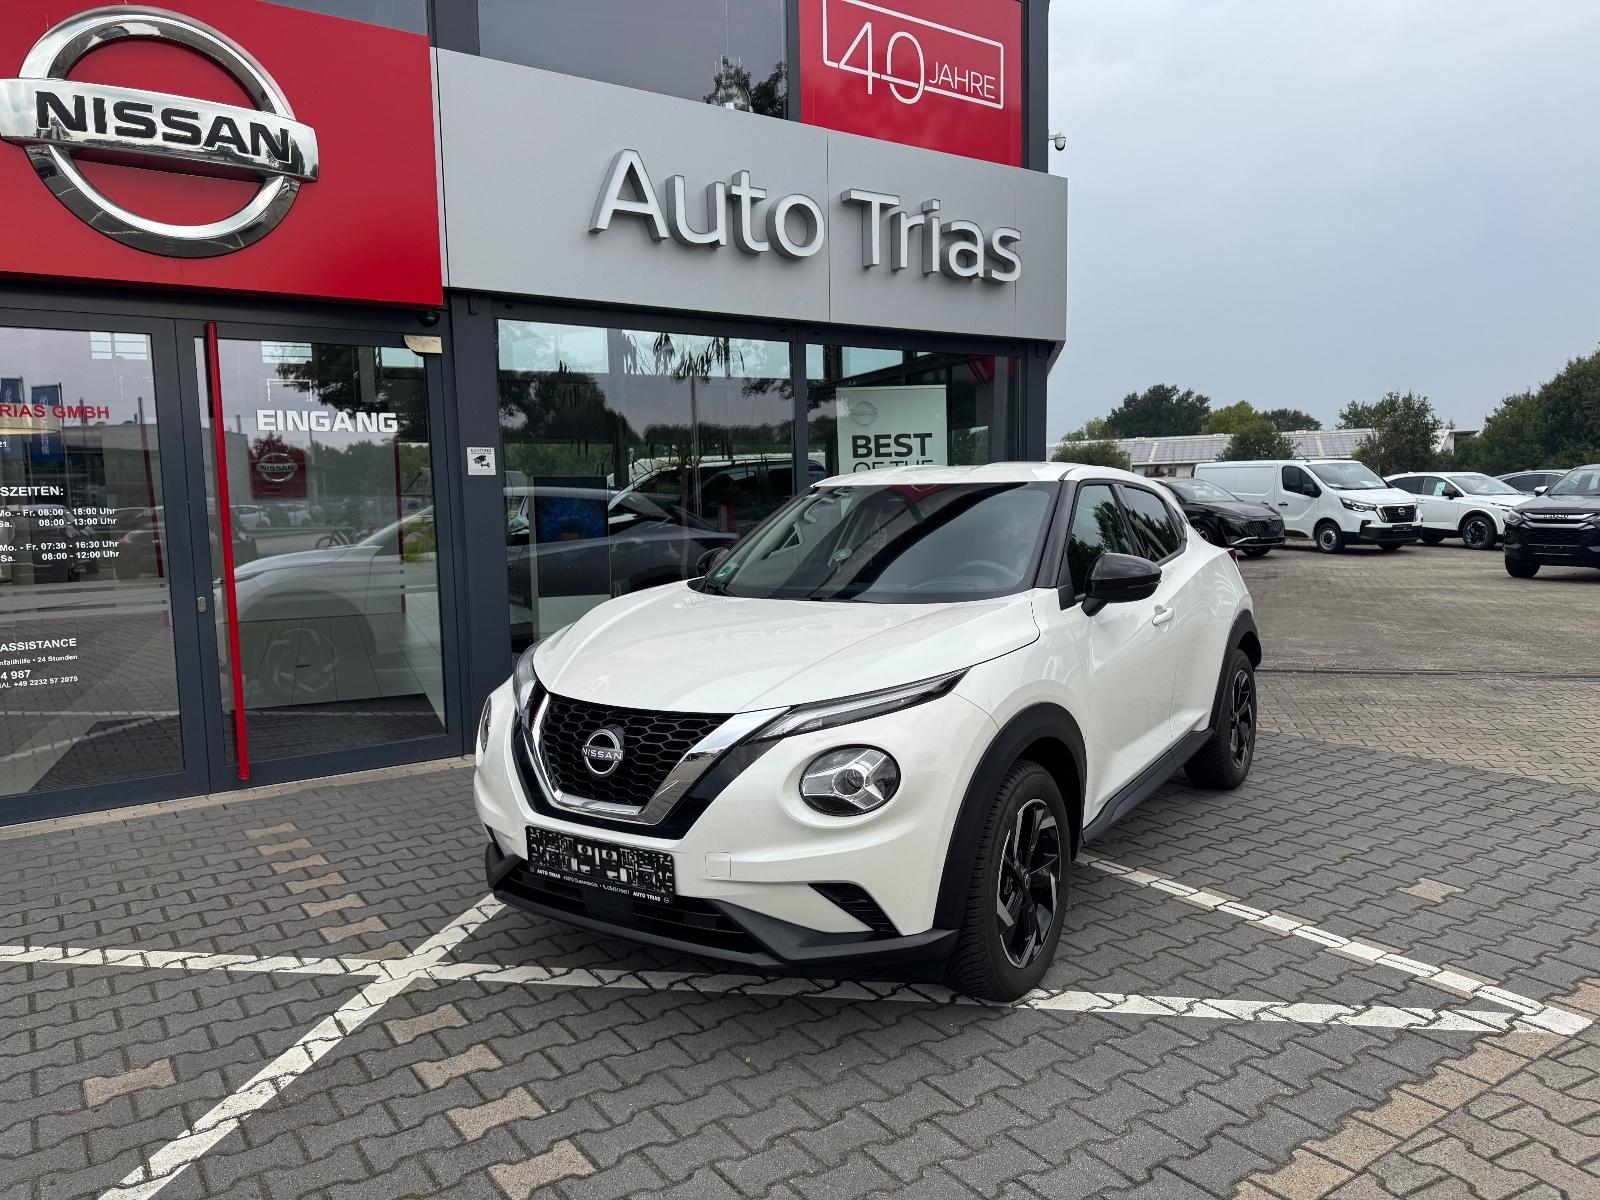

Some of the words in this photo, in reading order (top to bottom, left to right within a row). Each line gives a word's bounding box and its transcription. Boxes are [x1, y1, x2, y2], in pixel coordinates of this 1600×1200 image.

[837, 22, 925, 104] 40
[928, 62, 996, 99] JAHRE
[36, 90, 292, 162] NISSAN
[588, 149, 825, 259] Auto
[841, 188, 1022, 283] Trias
[52, 404, 110, 419] GMBH
[256, 409, 398, 433] EINGANG
[852, 432, 933, 458] BEST
[0, 486, 64, 497] SZEITEN:
[23, 509, 36, 517] Fr.
[38, 508, 64, 516] 08:00
[99, 507, 118, 515] Uhr
[39, 518, 65, 527] 08:00
[73, 518, 98, 526] 13:00
[100, 517, 118, 525] Uhr
[0, 543, 17, 552] Mo.
[26, 543, 39, 551] Fr.
[41, 542, 67, 550] 07:30
[102, 540, 120, 548] Uhr
[0, 553, 16, 562] Sa.
[42, 552, 68, 560] 08:00
[76, 551, 101, 559] 12:00
[103, 550, 120, 558] Uhr
[0, 637, 77, 652] ASSISTANCE
[47, 654, 78, 662] Stunden
[0, 671, 8, 680] 4
[10, 669, 31, 680] 987
[29, 678, 48, 686] 2232
[582, 747, 622, 760] NISSAN
[632, 891, 646, 899] AUTO
